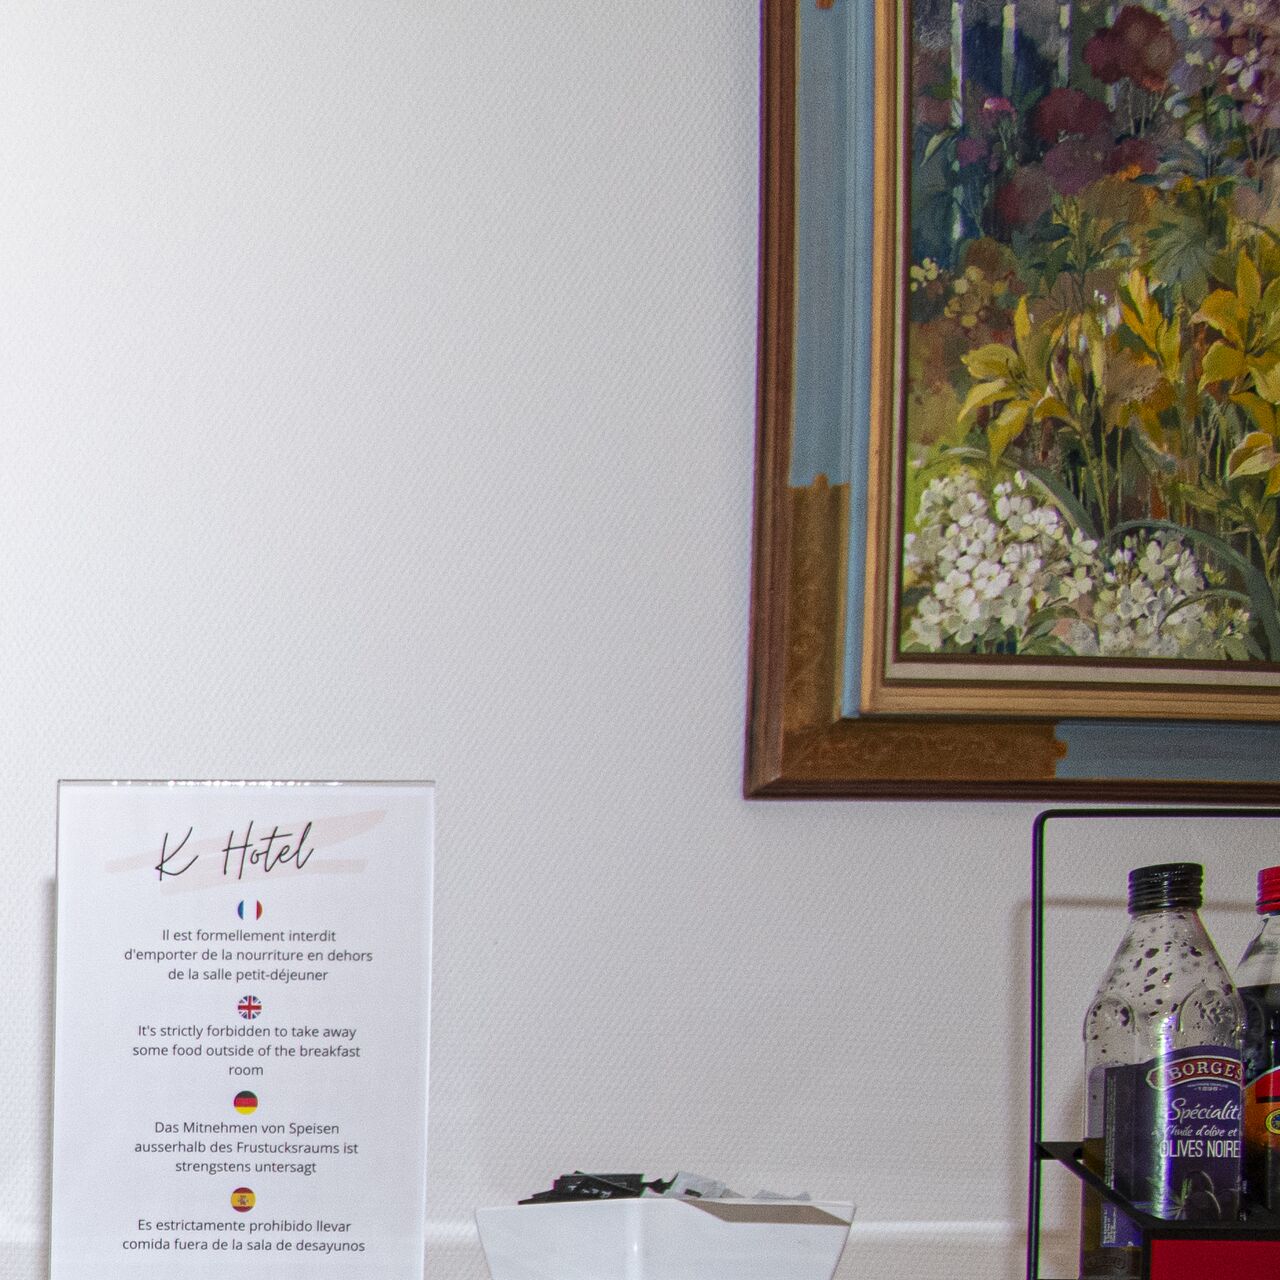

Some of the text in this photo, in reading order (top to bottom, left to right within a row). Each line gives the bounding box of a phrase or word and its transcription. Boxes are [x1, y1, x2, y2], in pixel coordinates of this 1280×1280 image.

[154, 820, 314, 882] K Hotel
[162, 929, 336, 942] Il est formellement interdit
[124, 948, 373, 964] d'emporter de la nourriture en dehors
[168, 968, 328, 984] de la salle petit-déjeuner
[138, 1025, 357, 1042] It's strictly forbidden to take away
[133, 1044, 360, 1058] some food outside of the breakfast
[229, 1066, 264, 1076] room
[155, 1122, 339, 1137] Das Mitnehmen von Speisen
[134, 1141, 359, 1154] ausserhalb des Frustucksraums ist
[1160, 1140, 1241, 1158] OLIVES NOIRE
[175, 1161, 317, 1176] strengstens untersagt
[138, 1219, 351, 1235] Es estrictamente prohibido llevar
[122, 1238, 365, 1255] comida fuera de la sala de desayunos
